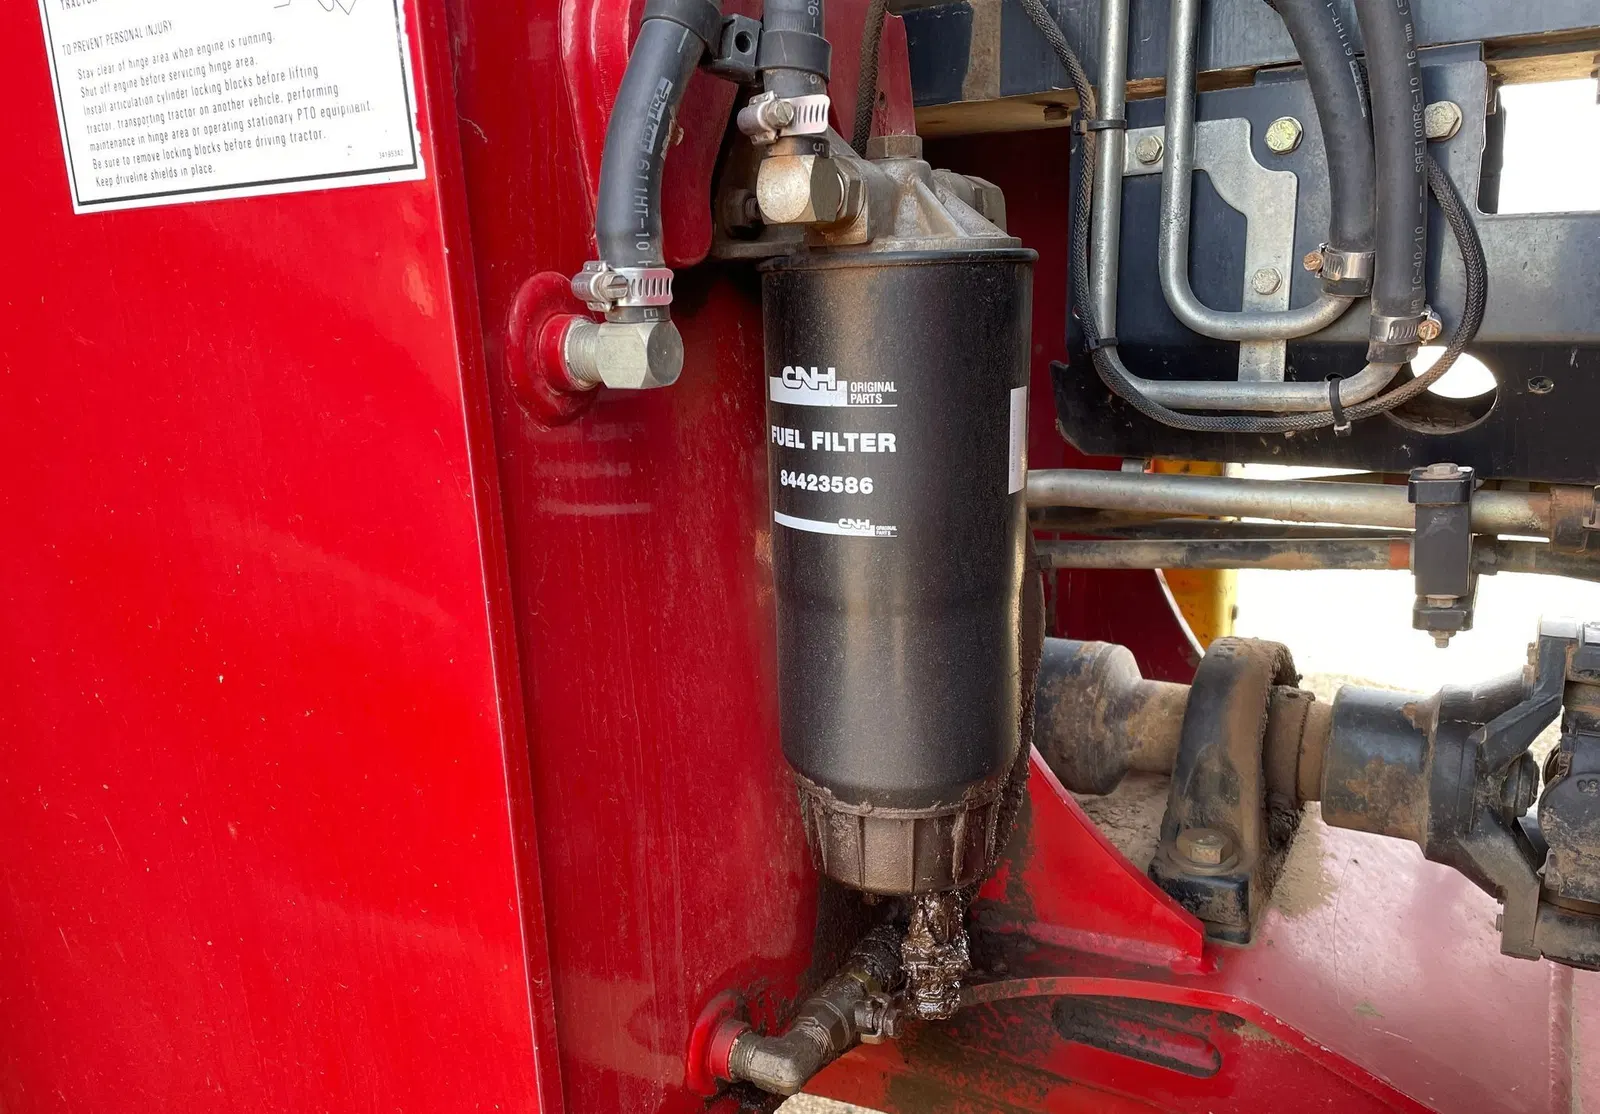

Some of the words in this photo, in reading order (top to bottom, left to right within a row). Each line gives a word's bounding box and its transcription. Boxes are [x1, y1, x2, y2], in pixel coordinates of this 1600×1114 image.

[62, 44, 72, 56] TO
[73, 36, 103, 52] PREVENT
[106, 28, 143, 46] PERSONAL
[146, 20, 173, 36] INJURY
[1405, 23, 1413, 42] mm
[78, 68, 94, 80] Stay
[98, 64, 115, 76] clear
[118, 59, 125, 71] of
[128, 56, 149, 70] hinge
[152, 52, 170, 64] area
[172, 46, 194, 60] when
[197, 41, 224, 56] engine
[228, 38, 235, 48] is
[238, 32, 276, 46] running.
[1407, 50, 1416, 67] 16
[80, 86, 97, 98] Shut
[100, 81, 111, 94] off
[114, 79, 138, 92] engine
[140, 72, 166, 86] before
[170, 65, 206, 81] servicing
[209, 59, 232, 74] hinge
[236, 56, 258, 68] area.
[84, 102, 107, 116] Install
[110, 95, 154, 112] articulation
[157, 88, 188, 104] cylinder
[192, 82, 222, 97] locking
[225, 76, 252, 92] blocks
[256, 71, 286, 86] before
[289, 66, 318, 79] lifting
[118, 112, 164, 129] transporting
[168, 106, 196, 120] tractor
[200, 106, 209, 116] on
[213, 100, 244, 113] another
[287, 84, 338, 102] performing
[643, 79, 672, 153] Parker
[1409, 76, 1424, 172] SAE100R6-10
[90, 137, 135, 152] maintenance
[138, 134, 145, 144] in
[148, 131, 168, 144] hinge
[172, 128, 189, 138] area
[192, 126, 200, 136] or
[204, 119, 244, 135] operating
[248, 112, 293, 128] stationary
[297, 106, 316, 120] PTO
[92, 158, 102, 170] Be
[105, 158, 120, 168] sure
[123, 155, 130, 165] to
[133, 152, 160, 164] remove
[163, 146, 192, 160] locking
[194, 142, 221, 156] blocks
[224, 138, 252, 151] before
[256, 134, 286, 148] driving
[290, 129, 326, 142] tractor.
[96, 176, 113, 188] Keep
[116, 172, 148, 185] driveline
[151, 167, 178, 180] shields
[180, 166, 188, 176] in
[191, 164, 216, 176] place.
[633, 157, 651, 251] 611HT-10
[782, 366, 836, 390] CNH
[850, 382, 897, 392] ORIGINAL
[850, 393, 882, 404] PARTS
[772, 425, 805, 450] FUEL
[812, 431, 896, 452] FILTER
[780, 470, 874, 494] 84423586
[838, 518, 870, 530] CNH
